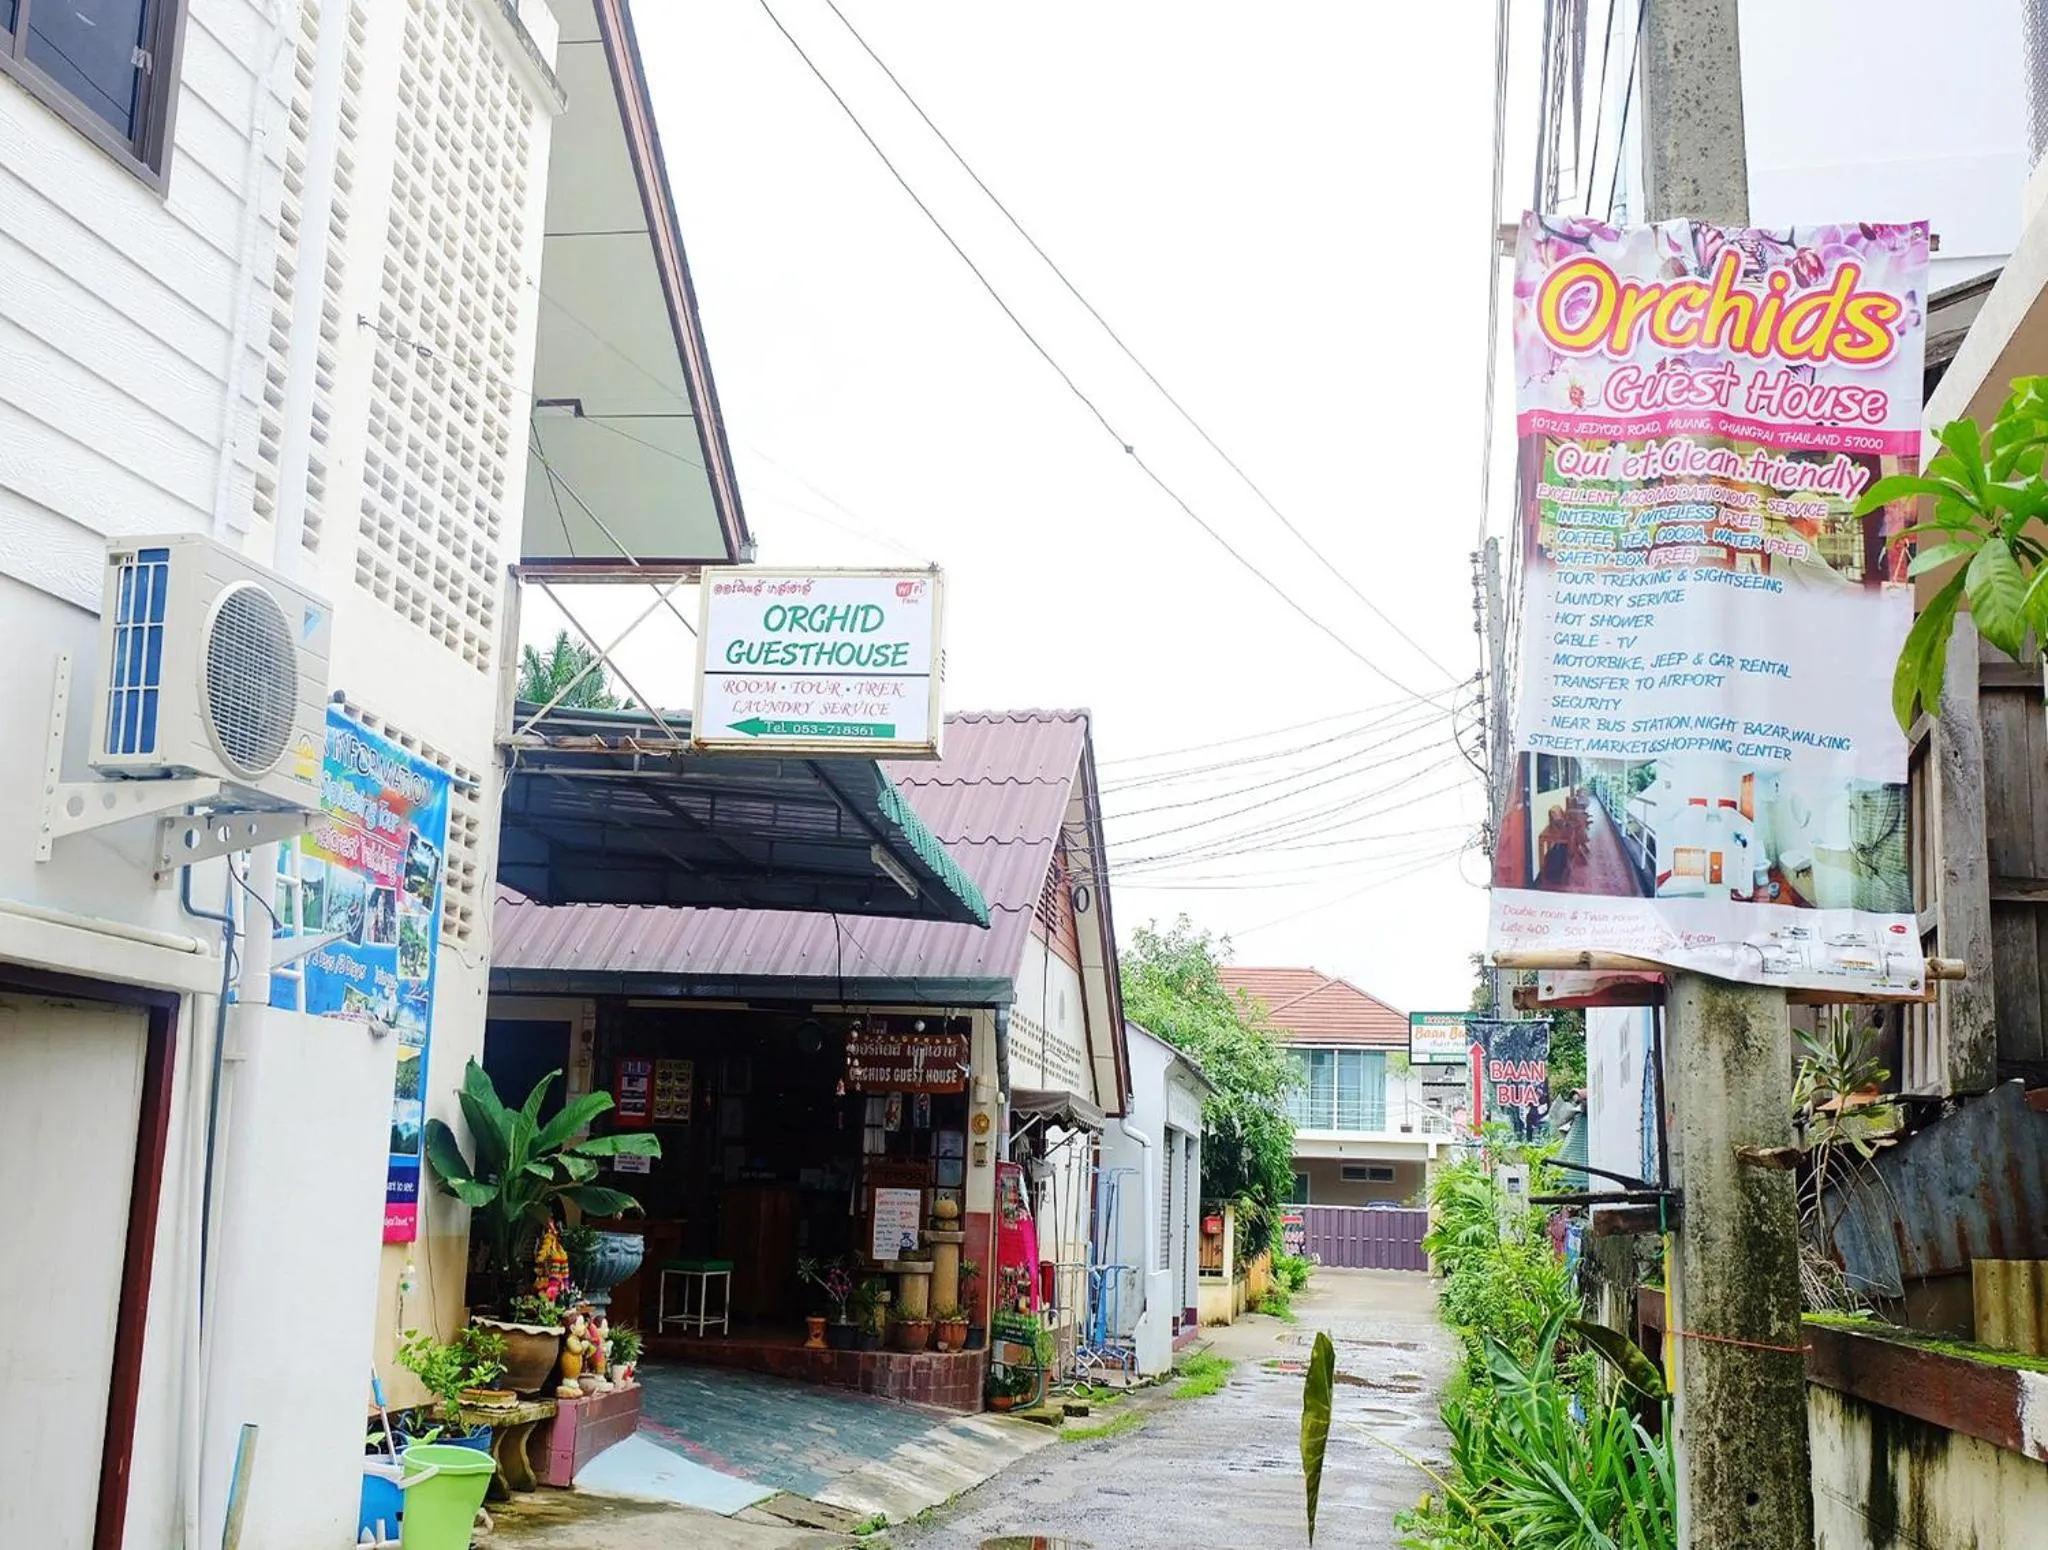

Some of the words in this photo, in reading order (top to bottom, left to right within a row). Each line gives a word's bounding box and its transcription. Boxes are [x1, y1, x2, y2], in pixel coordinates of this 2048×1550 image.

[1538, 251, 1901, 363] Orchids
[1604, 363, 1740, 414] Guest
[1745, 371, 1888, 424] House
[1627, 421, 1662, 434] ROAD,
[1667, 417, 1714, 432] MUANG,
[1719, 420, 1774, 442] CHIANGRAI
[1778, 432, 1840, 446] THAILAND
[1844, 436, 1884, 450] 57000
[1538, 484, 1615, 504] EXCELLENT
[1767, 499, 1828, 517] SERVICE
[1558, 509, 1629, 526] INTERNET
[1719, 509, 1764, 530] (FREE)
[1557, 530, 1615, 548] COFFEE,
[1657, 527, 1708, 543] COCOA,
[1714, 528, 1762, 549] WATER
[1764, 538, 1808, 560] (FREE)
[1649, 547, 1697, 565] (FREE)
[1556, 571, 1595, 585] TOUR
[1600, 570, 1671, 587] TREKKING
[1677, 570, 1687, 582] &
[1693, 569, 1783, 593] SIGHTSEEING
[1555, 591, 1623, 607] LAUNDRY
[1627, 589, 1686, 608] SERVICE
[763, 604, 885, 634] ORCHID
[1555, 612, 1585, 626] HOT
[1590, 614, 1655, 628] SHOWER
[1553, 632, 1600, 647] CABLE
[1616, 635, 1638, 649] TV
[726, 639, 909, 667] GUESTHOUSE
[1553, 654, 1645, 672] MOTORBIKE,
[1651, 652, 1688, 668] JEEP
[1692, 653, 1703, 666] &
[1708, 653, 1735, 669] CAR
[1739, 658, 1792, 679] RENTAL
[723, 679, 777, 696] ROOM
[790, 680, 842, 697] TOUR
[853, 681, 905, 698] TREK
[1552, 674, 1630, 690] TRANSFER
[1635, 677, 1656, 690] TO
[1658, 673, 1726, 689] AIRPORT
[731, 700, 813, 716] LAUNDRY
[819, 702, 891, 717] SERVICE
[1551, 695, 1622, 711] SECURITY
[1551, 715, 1590, 730] NEAR
[1596, 718, 1626, 732] BUS
[1736, 742, 1793, 761] CENTER
[333, 729, 434, 806] INFORMATION
[1527, 923, 1550, 935] 400
[893, 1067, 924, 1083] GUEST
[926, 1068, 958, 1084] HOUSE
[1490, 1060, 1546, 1082] BAAN
[1497, 1085, 1539, 1106] BUA
